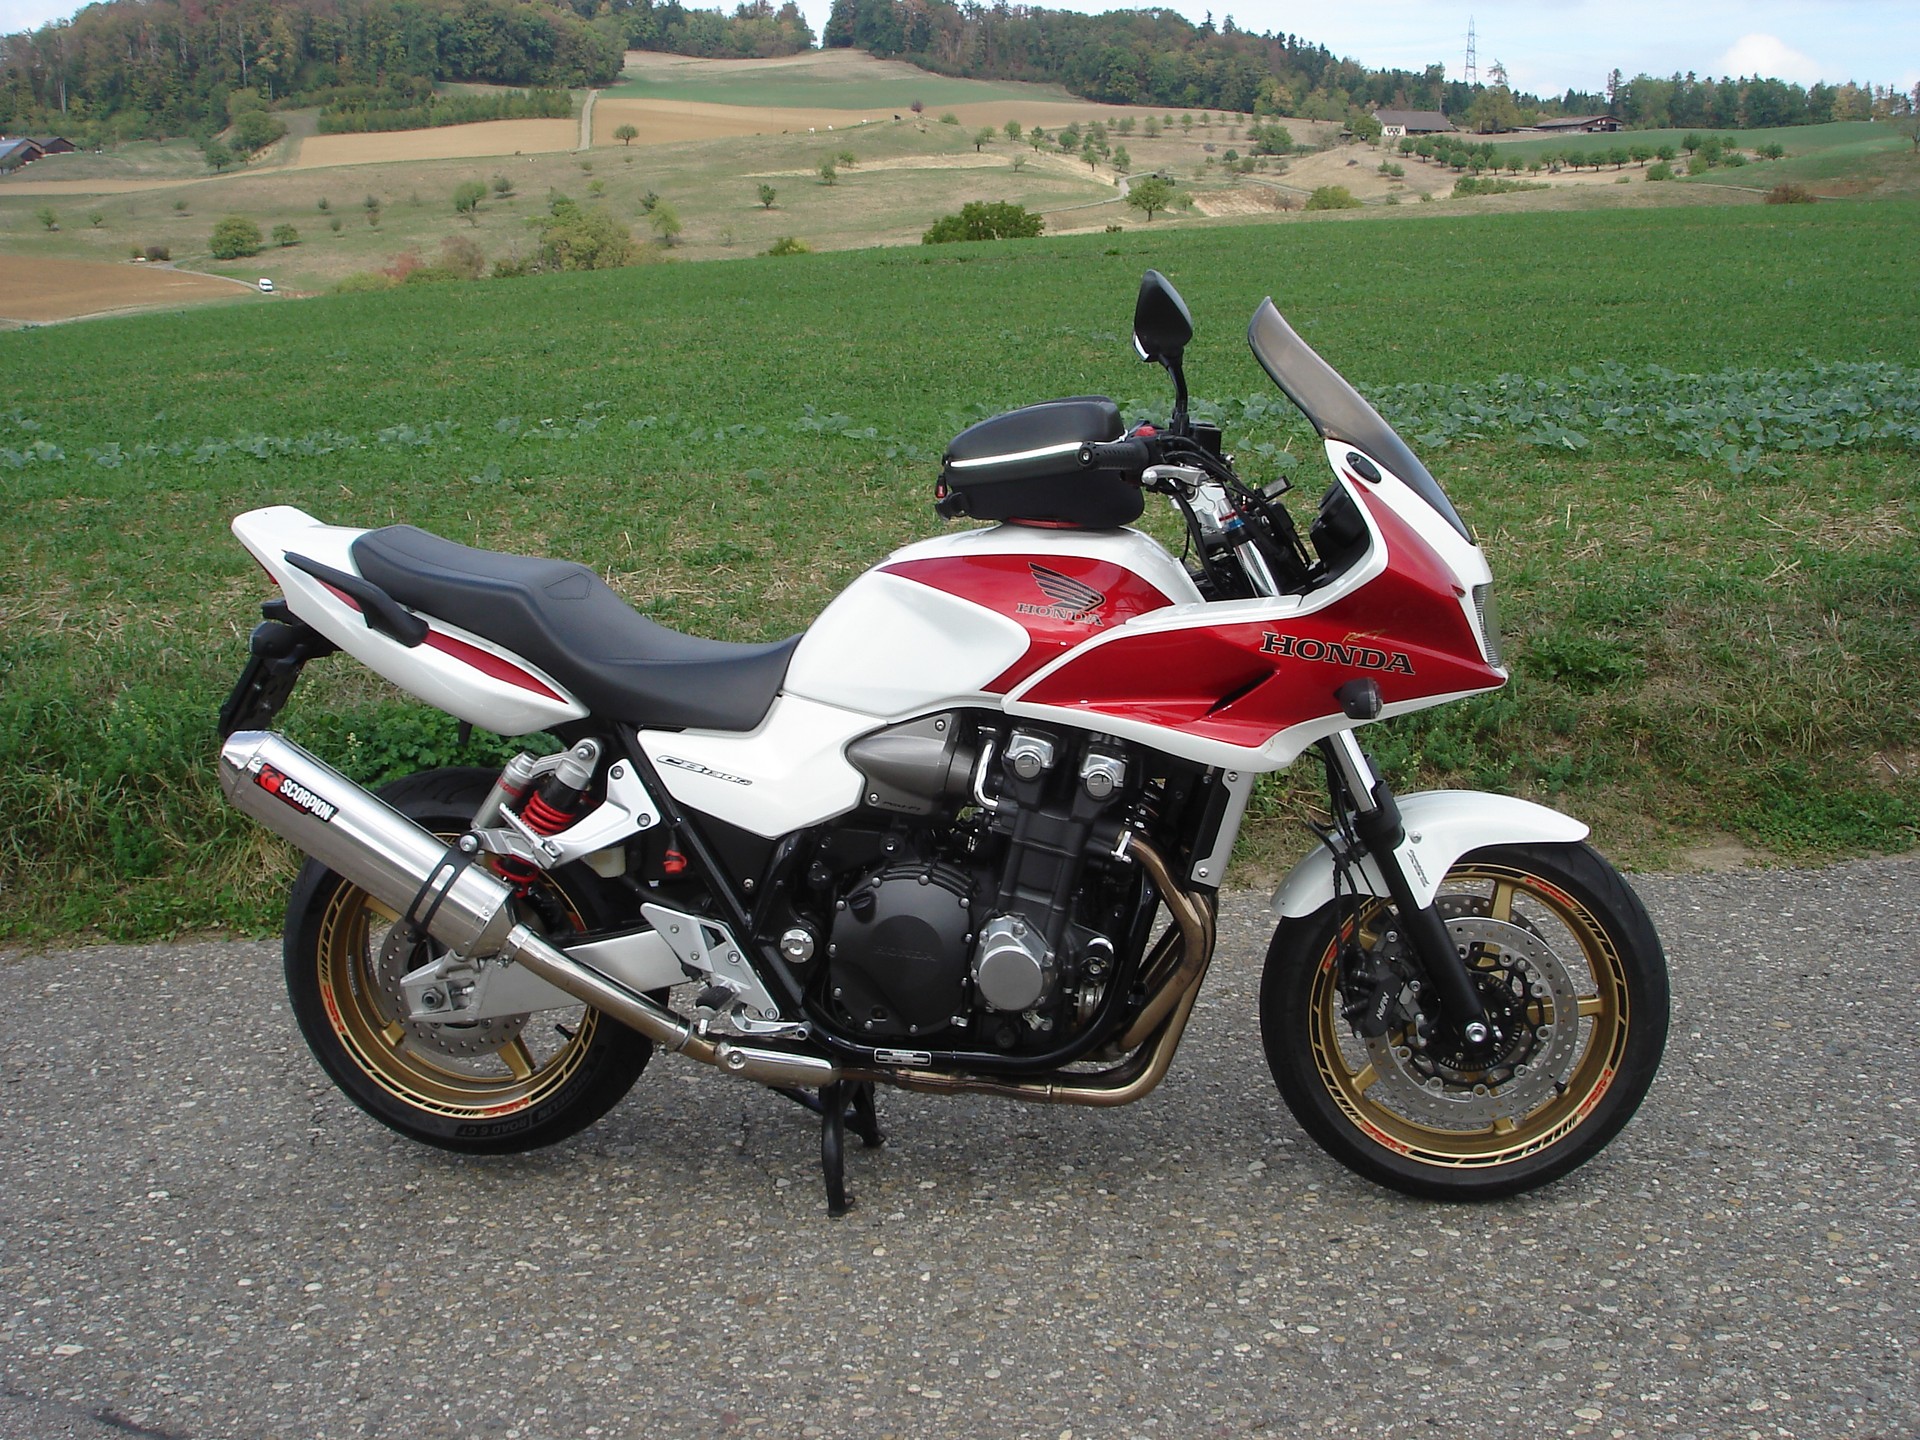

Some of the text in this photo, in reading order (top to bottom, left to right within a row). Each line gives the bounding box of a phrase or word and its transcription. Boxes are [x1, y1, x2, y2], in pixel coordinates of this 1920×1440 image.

[1016, 602, 1104, 627] HONDA
[1260, 631, 1416, 675] HONDA
[280, 779, 334, 821] SCORPION
